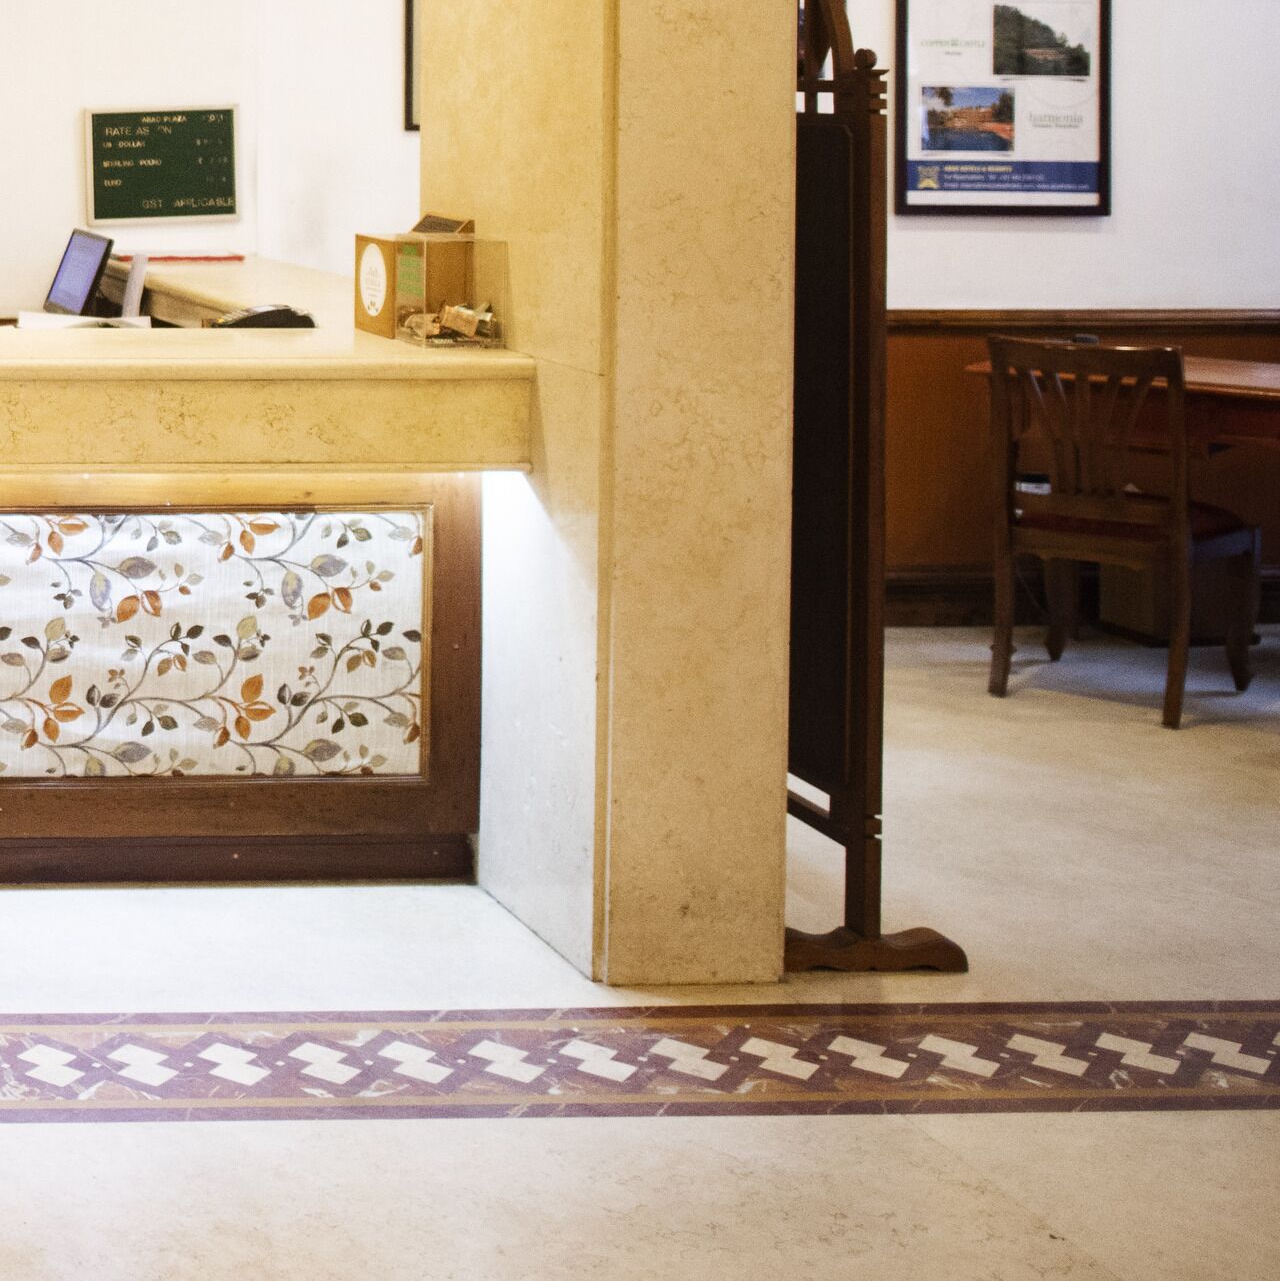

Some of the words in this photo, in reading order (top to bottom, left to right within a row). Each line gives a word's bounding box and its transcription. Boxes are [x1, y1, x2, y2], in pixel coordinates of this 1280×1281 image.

[105, 126, 132, 136] RATE
[135, 126, 150, 135] AS
[118, 140, 145, 148] DOLLAR
[104, 179, 122, 187] EURO
[142, 199, 163, 209] GST
[174, 197, 234, 208] APPLICABLE
